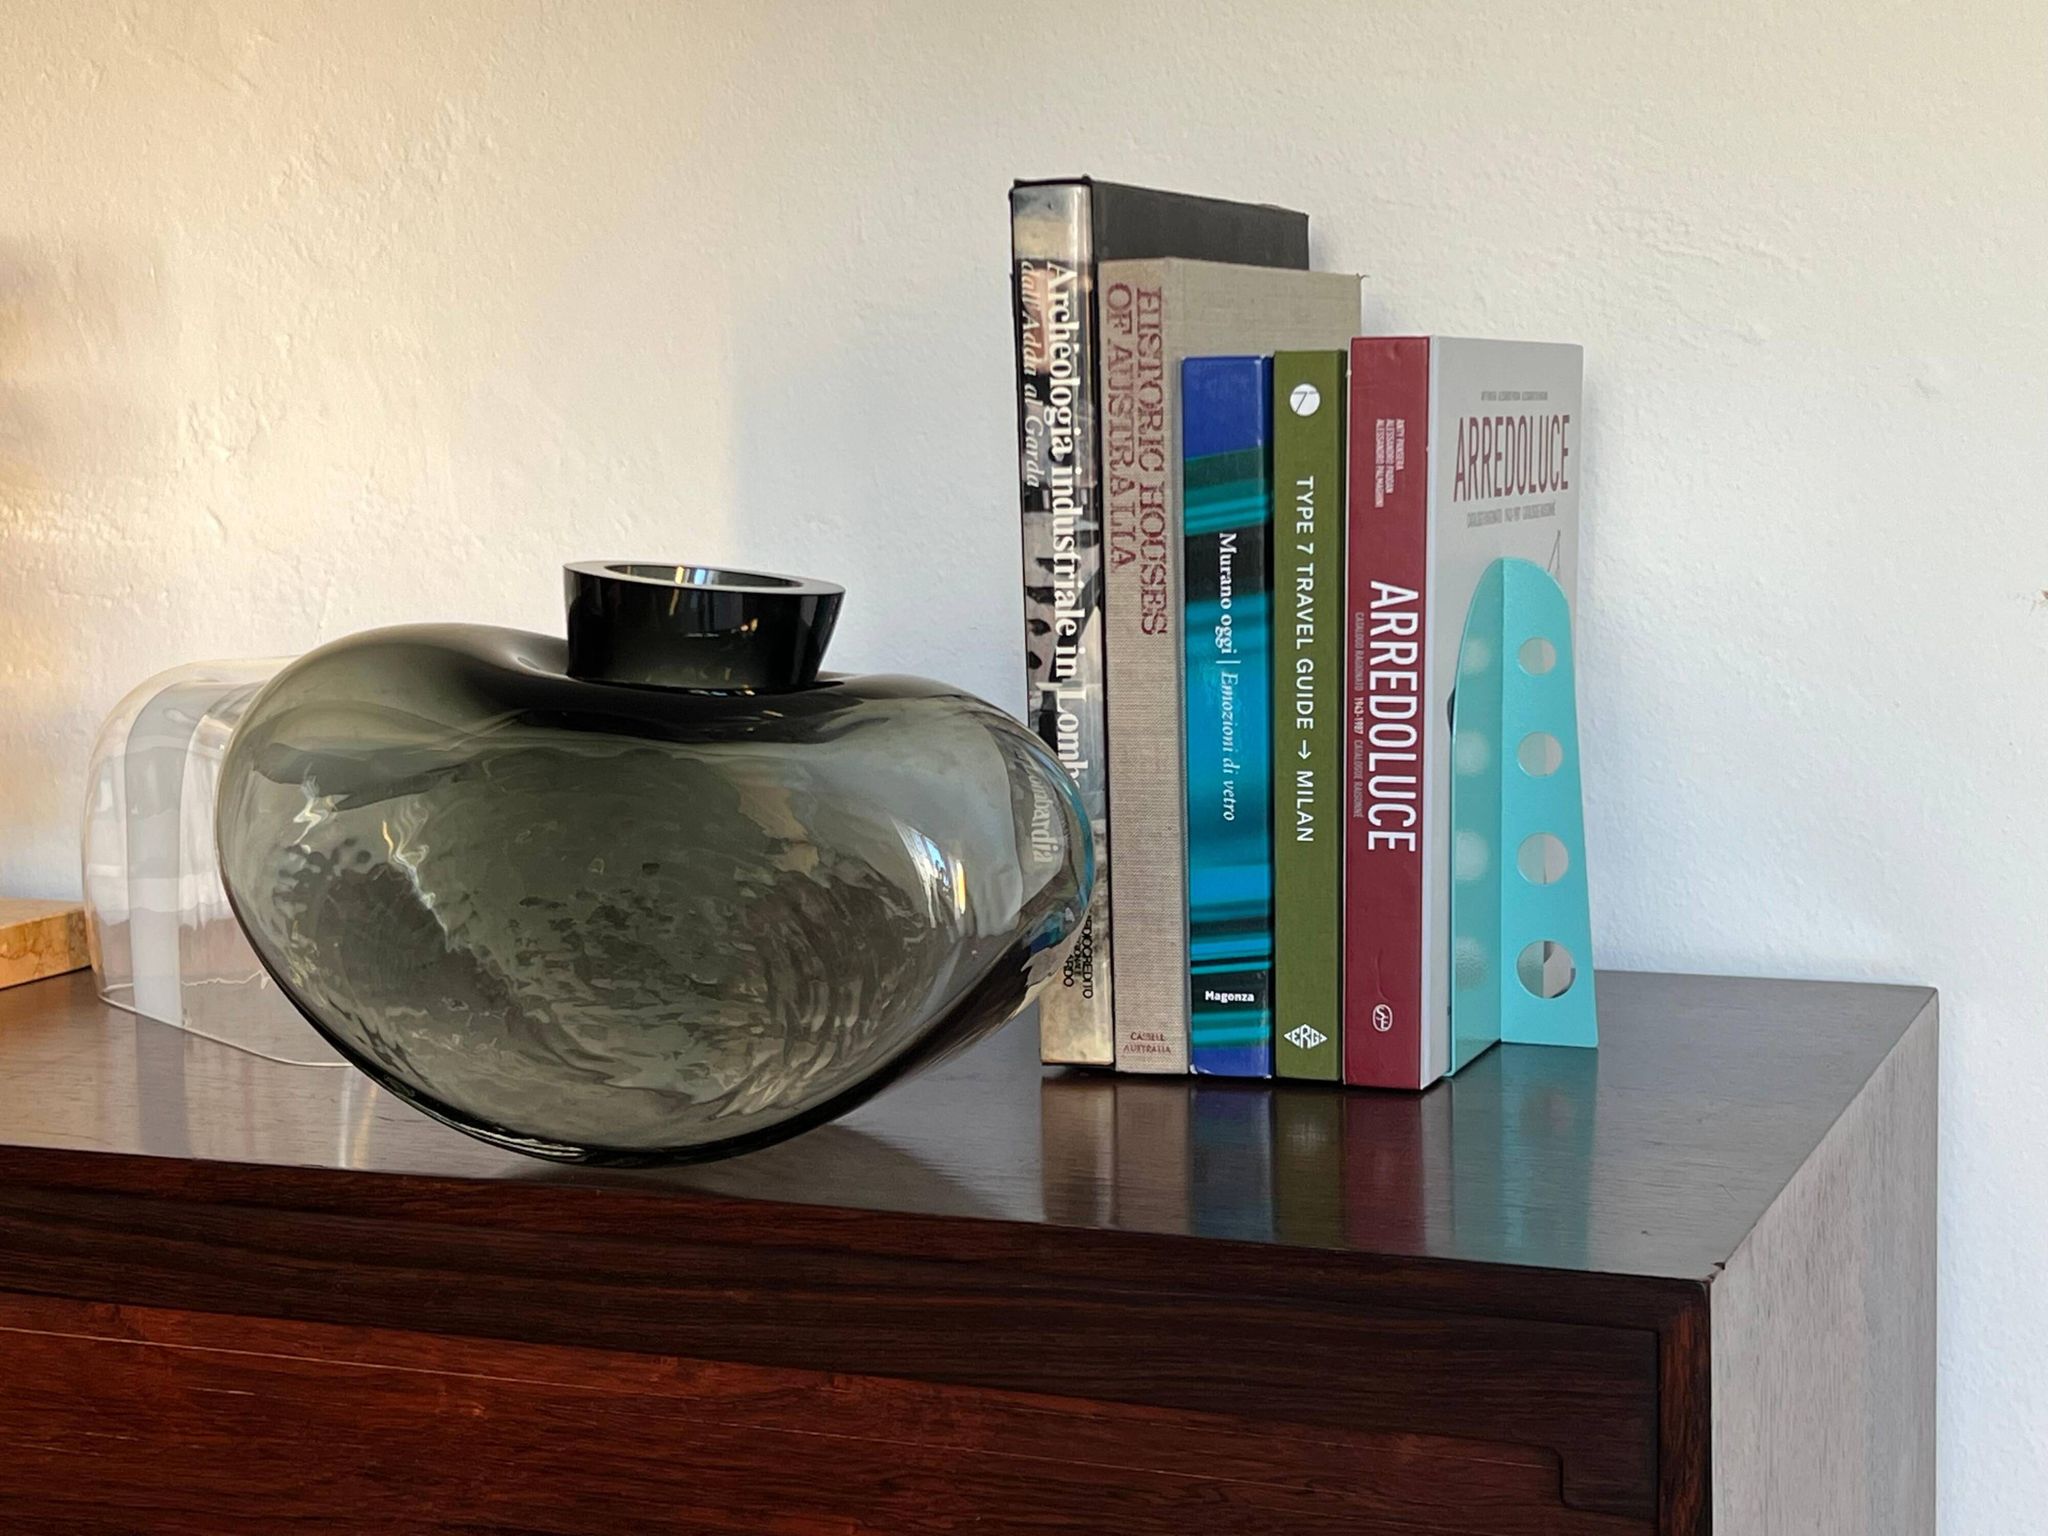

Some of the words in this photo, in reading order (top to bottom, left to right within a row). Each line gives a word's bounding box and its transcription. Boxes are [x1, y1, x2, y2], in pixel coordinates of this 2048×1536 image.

[1106, 283, 1134, 335] OF
[1024, 383, 1042, 406] al
[1045, 261, 1083, 460] Archeologia
[1136, 286, 1165, 473] HISTORIC
[1026, 414, 1045, 489] Garda
[1107, 339, 1137, 573] AUSTRALIA
[1453, 414, 1571, 503] ARREDOLUCE
[1296, 475, 1314, 534] TYPE
[1050, 466, 1086, 636] industriale
[1139, 480, 1169, 636] HOUSES
[1218, 532, 1237, 609] Murano
[1296, 542, 1314, 555] 7
[1216, 618, 1238, 655] oggi
[1296, 562, 1314, 650] TRAVEL
[1055, 645, 1087, 678] in
[1296, 658, 1314, 730] GUIDE
[1057, 690, 1090, 789] Lomb
[1220, 670, 1240, 754] Emozioni
[1367, 580, 1420, 853] ARREDOLUCE
[1222, 779, 1236, 822] vetro
[1223, 755, 1241, 776] di
[1296, 770, 1314, 842] MILAN
[1082, 915, 1094, 999] EDIOCREDITO
[1204, 989, 1256, 1004] Magonza
